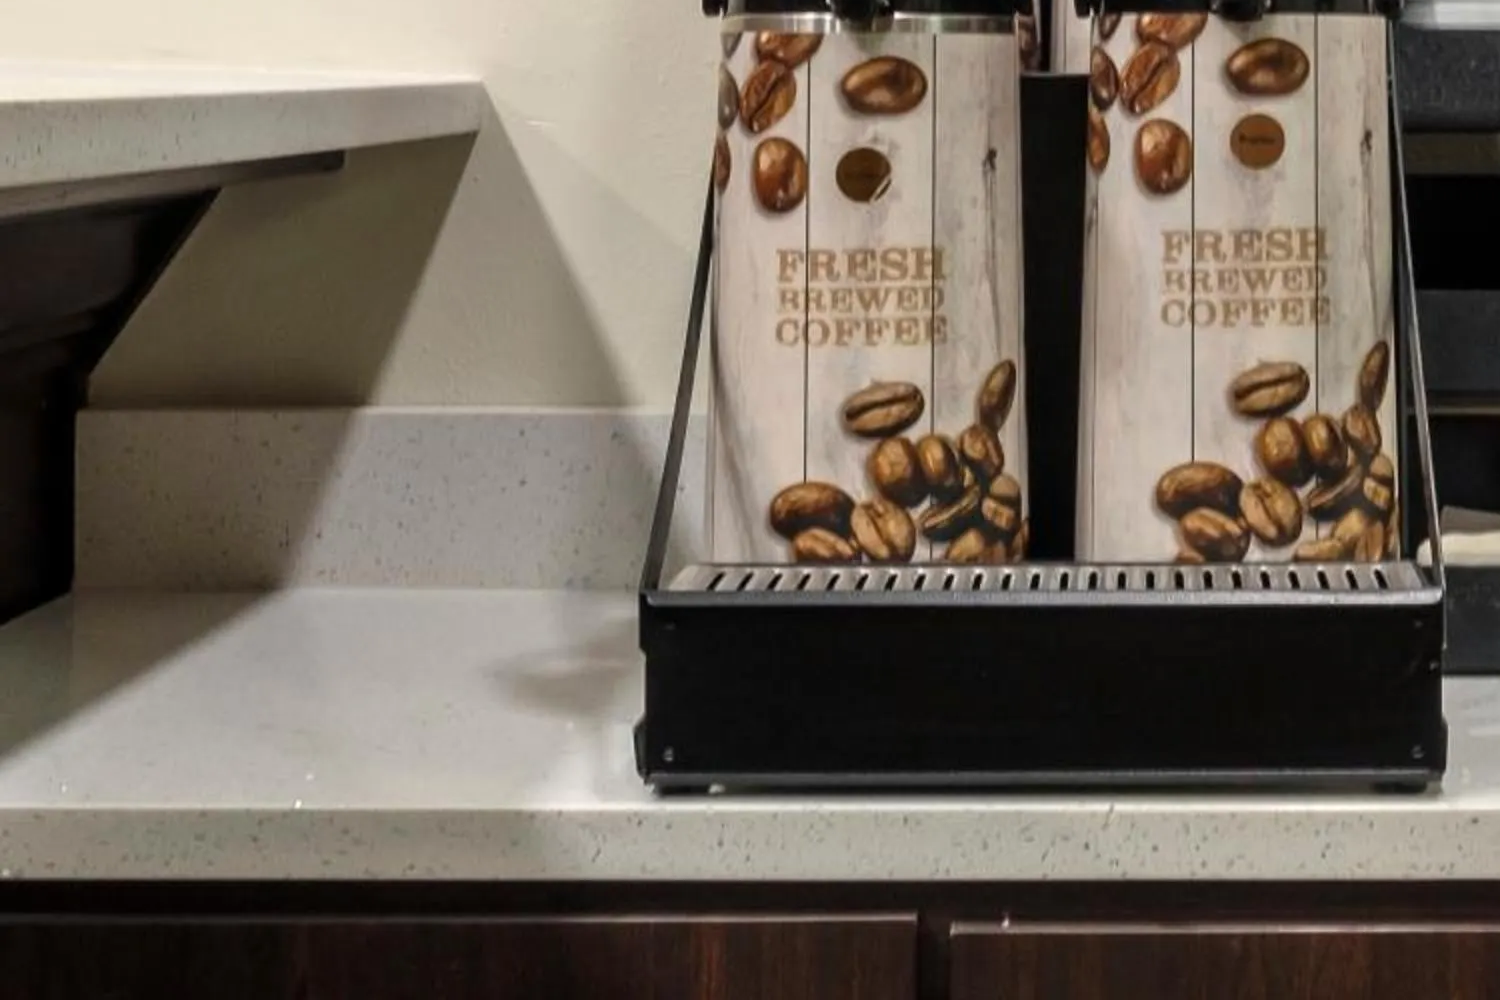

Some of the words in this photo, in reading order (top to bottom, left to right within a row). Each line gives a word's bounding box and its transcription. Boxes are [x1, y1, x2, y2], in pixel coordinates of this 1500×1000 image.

[1160, 227, 1328, 263] FRESH
[775, 247, 946, 283] FRESH
[1162, 265, 1328, 295] BREWED
[777, 285, 946, 313] BREWED
[1160, 296, 1331, 328] COFFEE
[775, 314, 948, 347] COFFEE
